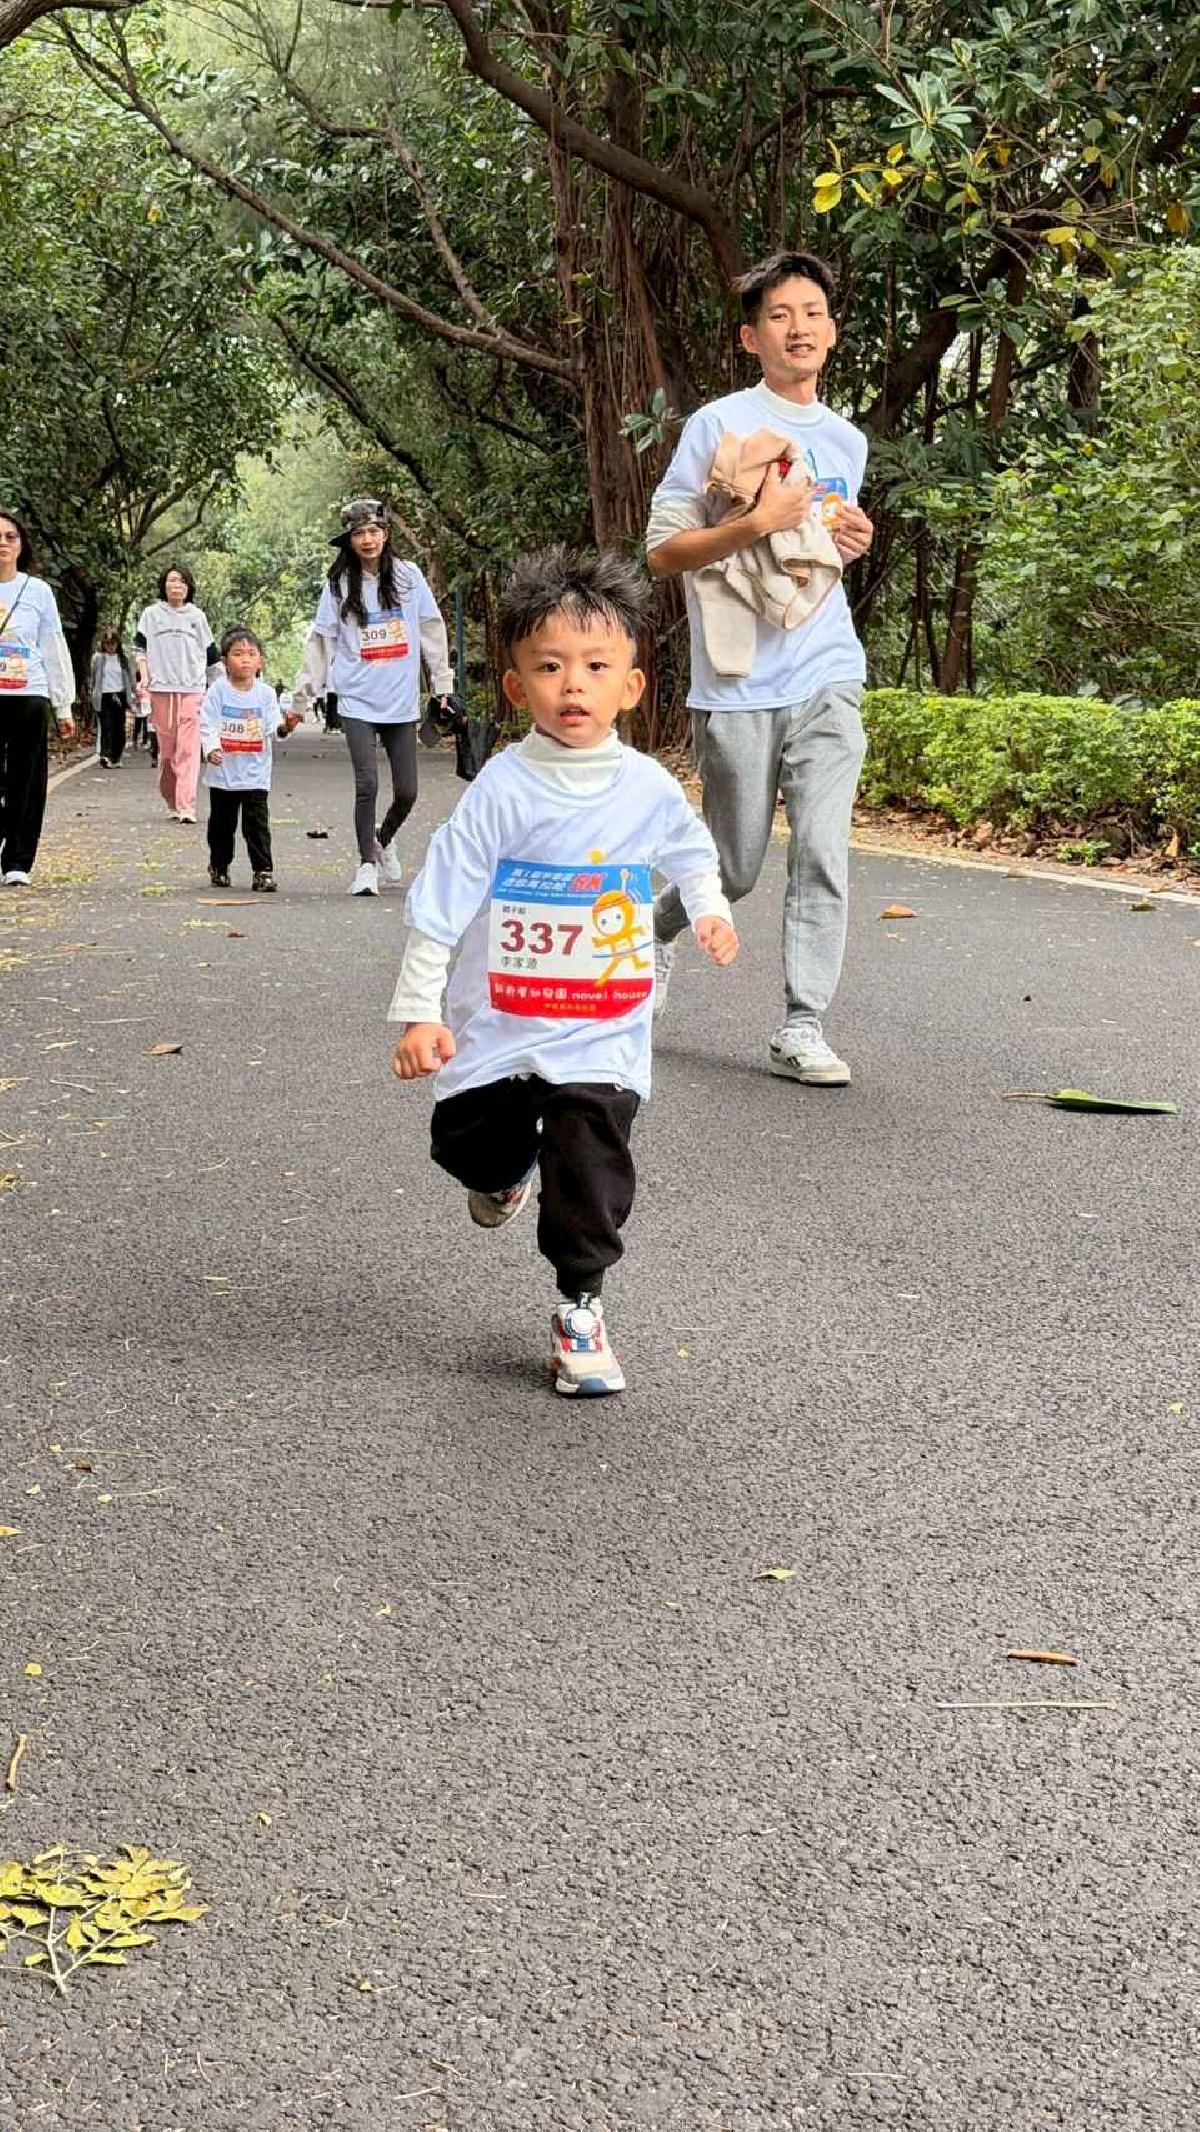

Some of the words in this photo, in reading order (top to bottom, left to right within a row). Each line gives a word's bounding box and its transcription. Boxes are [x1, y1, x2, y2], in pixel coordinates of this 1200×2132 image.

[361, 629, 387, 641] 309
[221, 721, 244, 733] 308
[500, 919, 583, 955] 337
